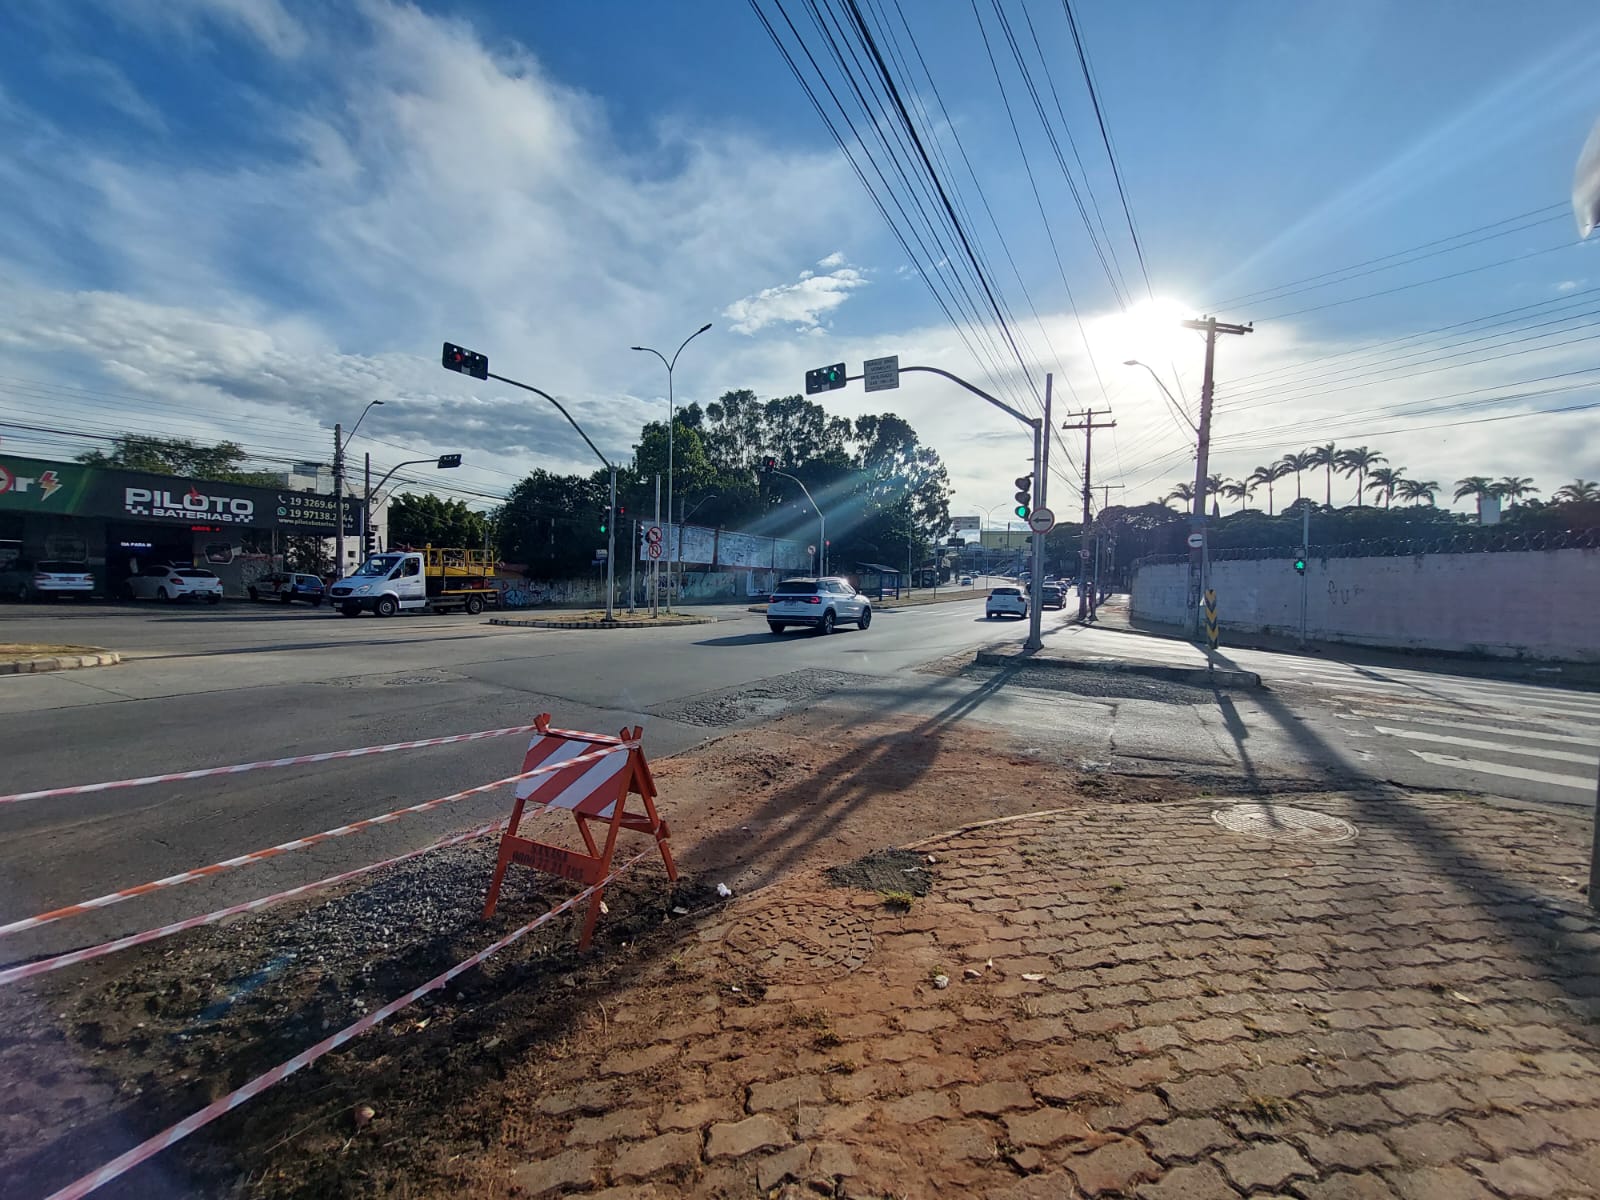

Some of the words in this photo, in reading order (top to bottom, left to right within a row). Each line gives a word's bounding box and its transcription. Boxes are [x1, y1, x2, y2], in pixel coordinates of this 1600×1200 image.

[125, 487, 254, 515] PILOTO
[289, 497, 302, 506] 19
[152, 508, 232, 522] BATERIAS
[289, 509, 301, 518] 19
